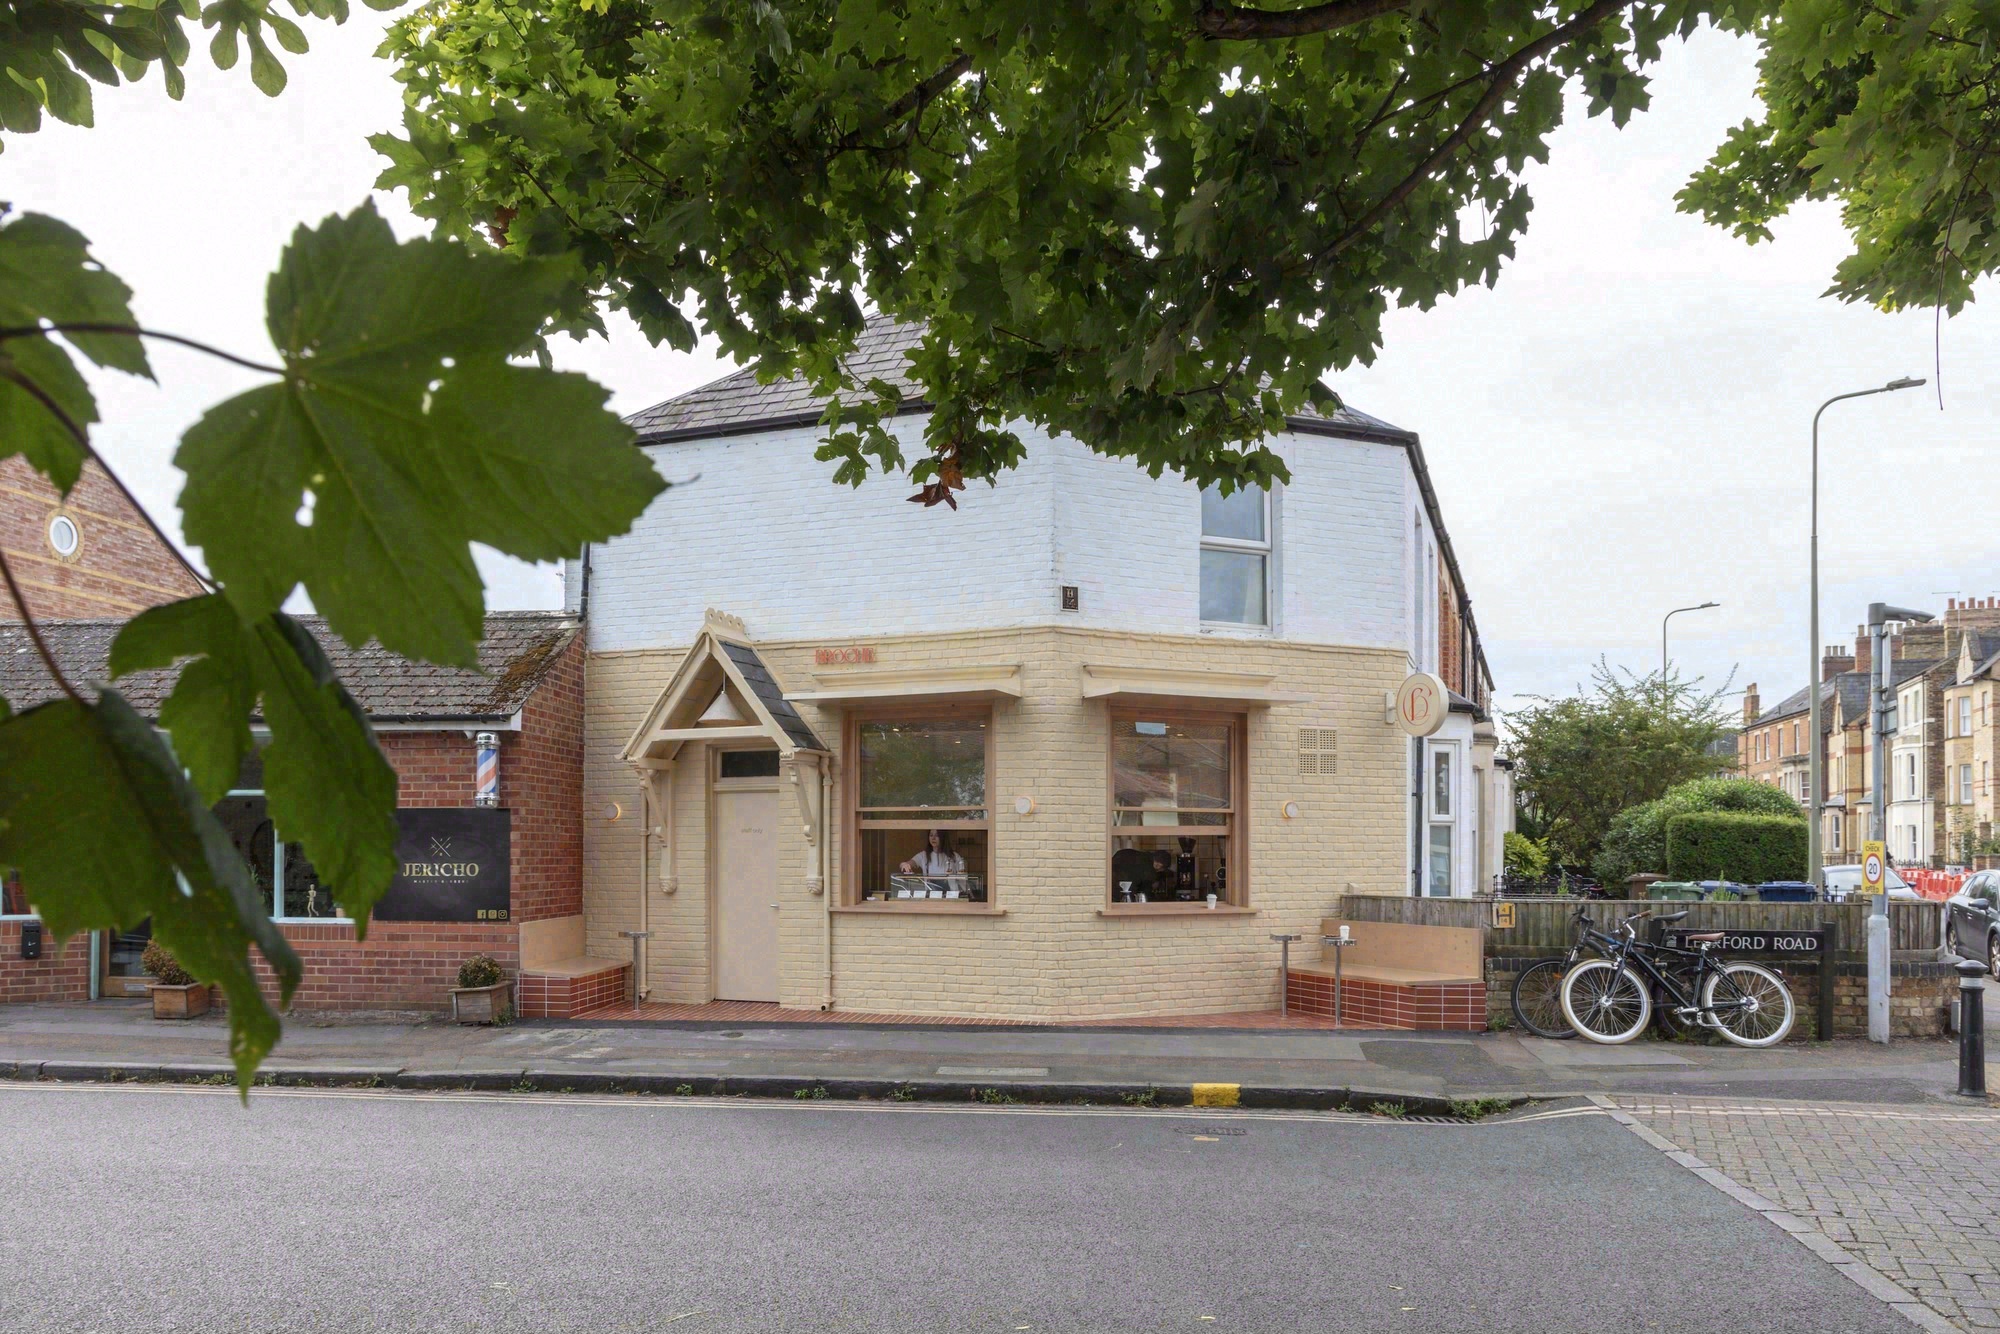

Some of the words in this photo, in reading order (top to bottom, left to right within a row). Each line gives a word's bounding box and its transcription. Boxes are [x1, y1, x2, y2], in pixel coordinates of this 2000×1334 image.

[402, 862, 480, 877] JERICHO
[1868, 863, 1878, 875] 20
[1773, 937, 1817, 950] ROAD
